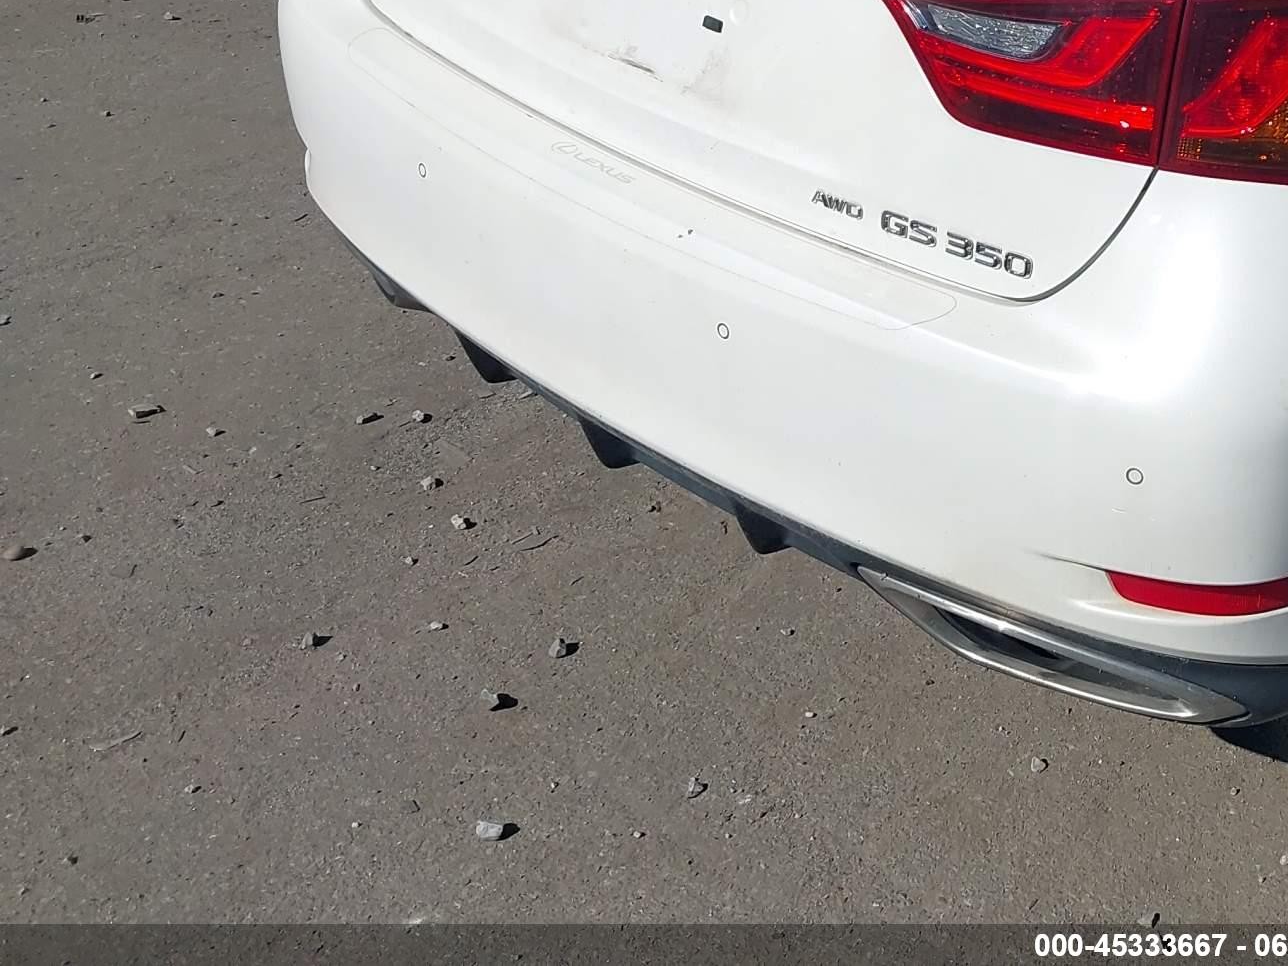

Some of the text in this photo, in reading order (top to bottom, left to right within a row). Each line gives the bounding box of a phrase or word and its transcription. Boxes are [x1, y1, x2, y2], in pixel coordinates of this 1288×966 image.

[811, 189, 1034, 279] AWD GS 350
